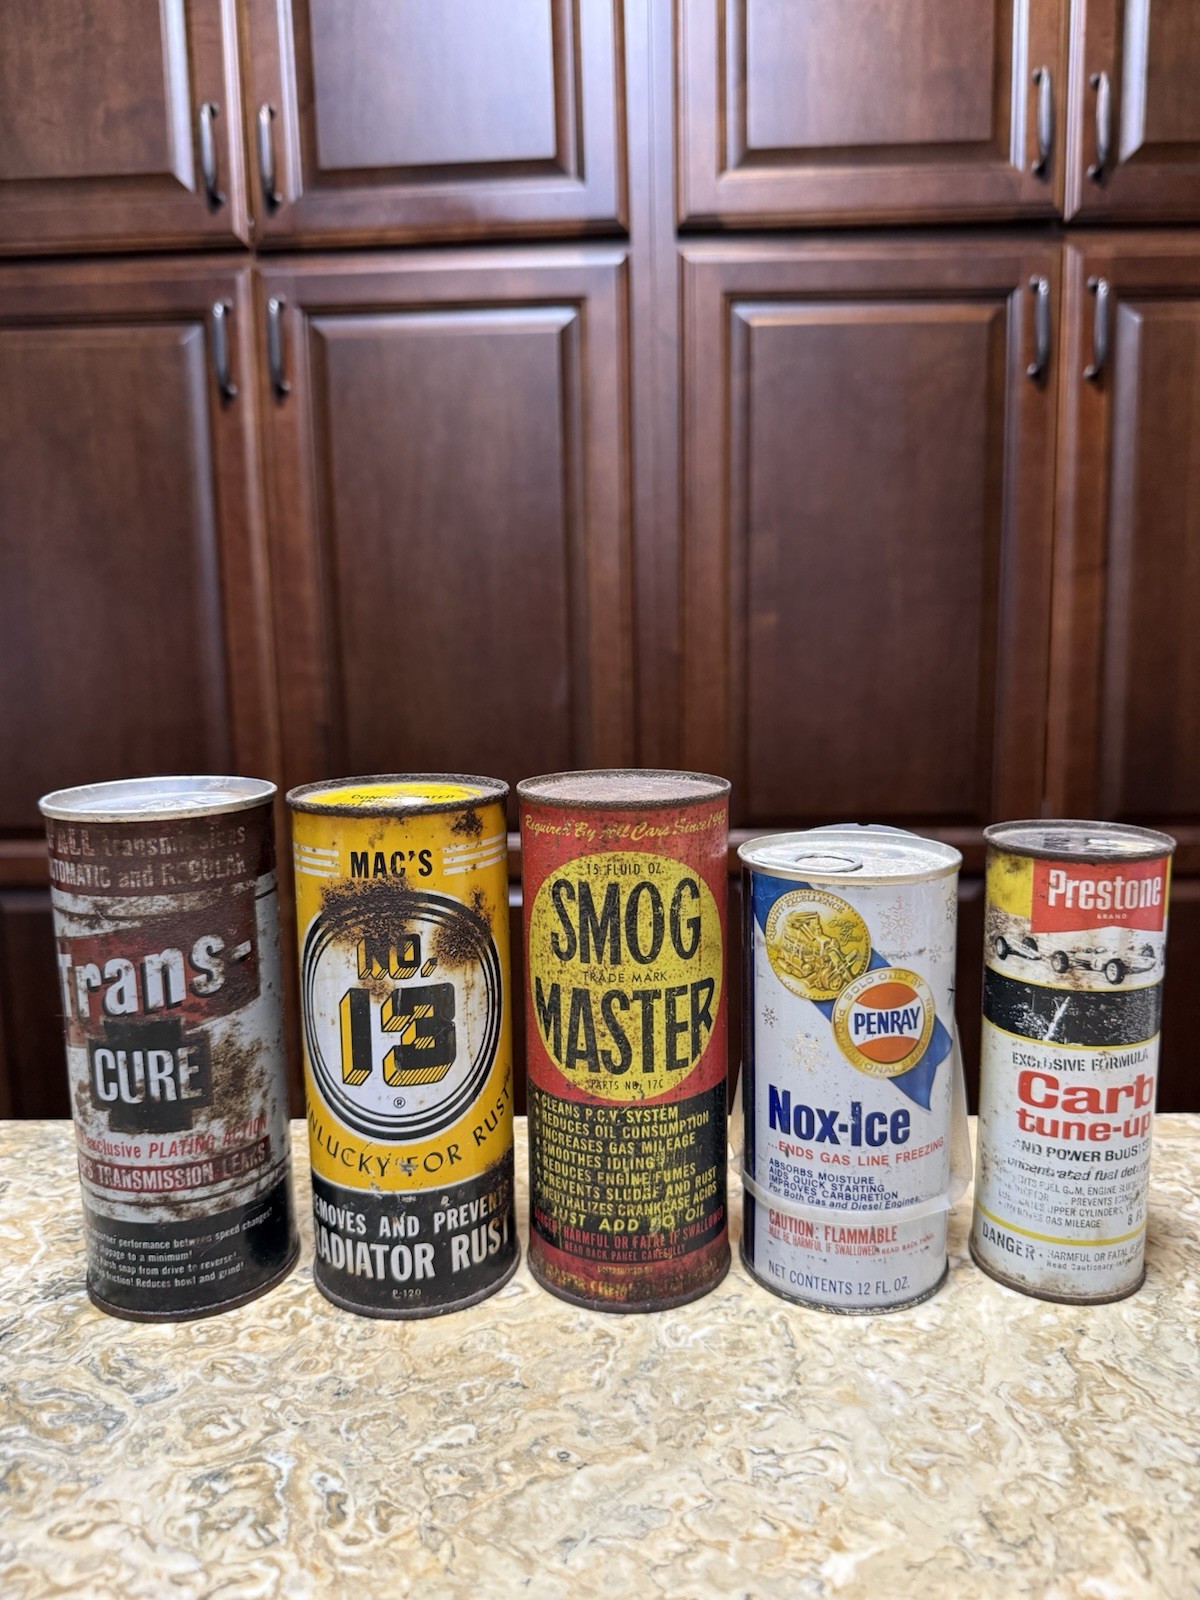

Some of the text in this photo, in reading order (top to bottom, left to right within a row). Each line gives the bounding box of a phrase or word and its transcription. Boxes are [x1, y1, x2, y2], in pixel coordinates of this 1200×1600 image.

[574, 821, 597, 843] By
[630, 821, 670, 841] Cars
[119, 863, 154, 888] and
[350, 849, 433, 879] MAC'S
[586, 862, 664, 876] 15 FLUID OZ.
[1047, 868, 1162, 911] Prestone
[551, 877, 701, 964] SMOG
[1096, 913, 1128, 921] BRAND
[583, 970, 668, 984] TRADE MARK
[338, 982, 457, 1088] 13
[534, 976, 716, 1077] MASTER
[853, 1005, 921, 1036] PENRAY
[94, 1048, 203, 1104] CURE
[590, 1079, 619, 1091] PARTS
[1016, 1069, 1155, 1115] Carb
[541, 1093, 679, 1124] CLEANS P.C.V. SYSTEM
[768, 1084, 912, 1148] Nox-Ice
[541, 1109, 709, 1140] REDUCES OIL CONSUMPTION
[1015, 1106, 1152, 1142] tune-up
[86, 1136, 142, 1159] exclusive
[541, 1123, 697, 1155] INCREASES GAS MILEAGE
[820, 1151, 852, 1167] GAS
[856, 1154, 890, 1167] LINE
[894, 1136, 945, 1165] FREEZING
[542, 1139, 655, 1171] SMOOTHES IDLING
[1046, 1145, 1101, 1163] POWER
[97, 1162, 214, 1191] TRANSMISSION
[542, 1154, 696, 1187] REDUCES ENGINE FUMES
[543, 1169, 601, 1200] PREVENTS
[665, 1180, 691, 1198] AND
[694, 1165, 717, 1189] RUST
[768, 1157, 876, 1185] ABSORBS MOISTURE
[768, 1166, 886, 1194] AIDS QUICK STARTING
[1094, 1169, 1119, 1181] fuel
[617, 1194, 691, 1218] CRANKCASE
[692, 1180, 717, 1205] ACIDS
[768, 1173, 899, 1202] IMPROVES CARBURETION
[768, 1182, 781, 1194] For
[783, 1188, 805, 1202] Both
[807, 1195, 826, 1207] Gas
[829, 1201, 848, 1210] and
[851, 1201, 883, 1211] Diesel
[1071, 1196, 1113, 1208] PREVENTS
[1087, 1185, 1117, 1197] ENGINE
[378, 1212, 420, 1239] AND
[551, 1205, 587, 1228] JUST
[598, 1217, 640, 1233] ADD
[685, 1203, 706, 1222] OIL
[768, 1207, 899, 1245] CAUTION: FLAMMABLE
[1045, 1214, 1101, 1229] GAS MILEAGE
[118, 1239, 172, 1250] performance
[214, 1223, 241, 1242] speed
[450, 1205, 511, 1274] RUST
[562, 1225, 610, 1249] HARMFUL
[613, 1235, 630, 1250] OR
[792, 1233, 822, 1251] HARMFUL
[825, 1242, 832, 1254] IF
[982, 1220, 1036, 1261] DANGER
[127, 1251, 137, 1261] to
[139, 1254, 146, 1262] a
[138, 1265, 160, 1275] from
[161, 1264, 185, 1275] drive
[610, 1250, 638, 1261] PANEL
[1093, 1252, 1106, 1262] OR
[135, 1277, 172, 1289] Reduces
[199, 1270, 216, 1285] and
[768, 1259, 911, 1296] NET CONTENTS 12 FL. OZ.
